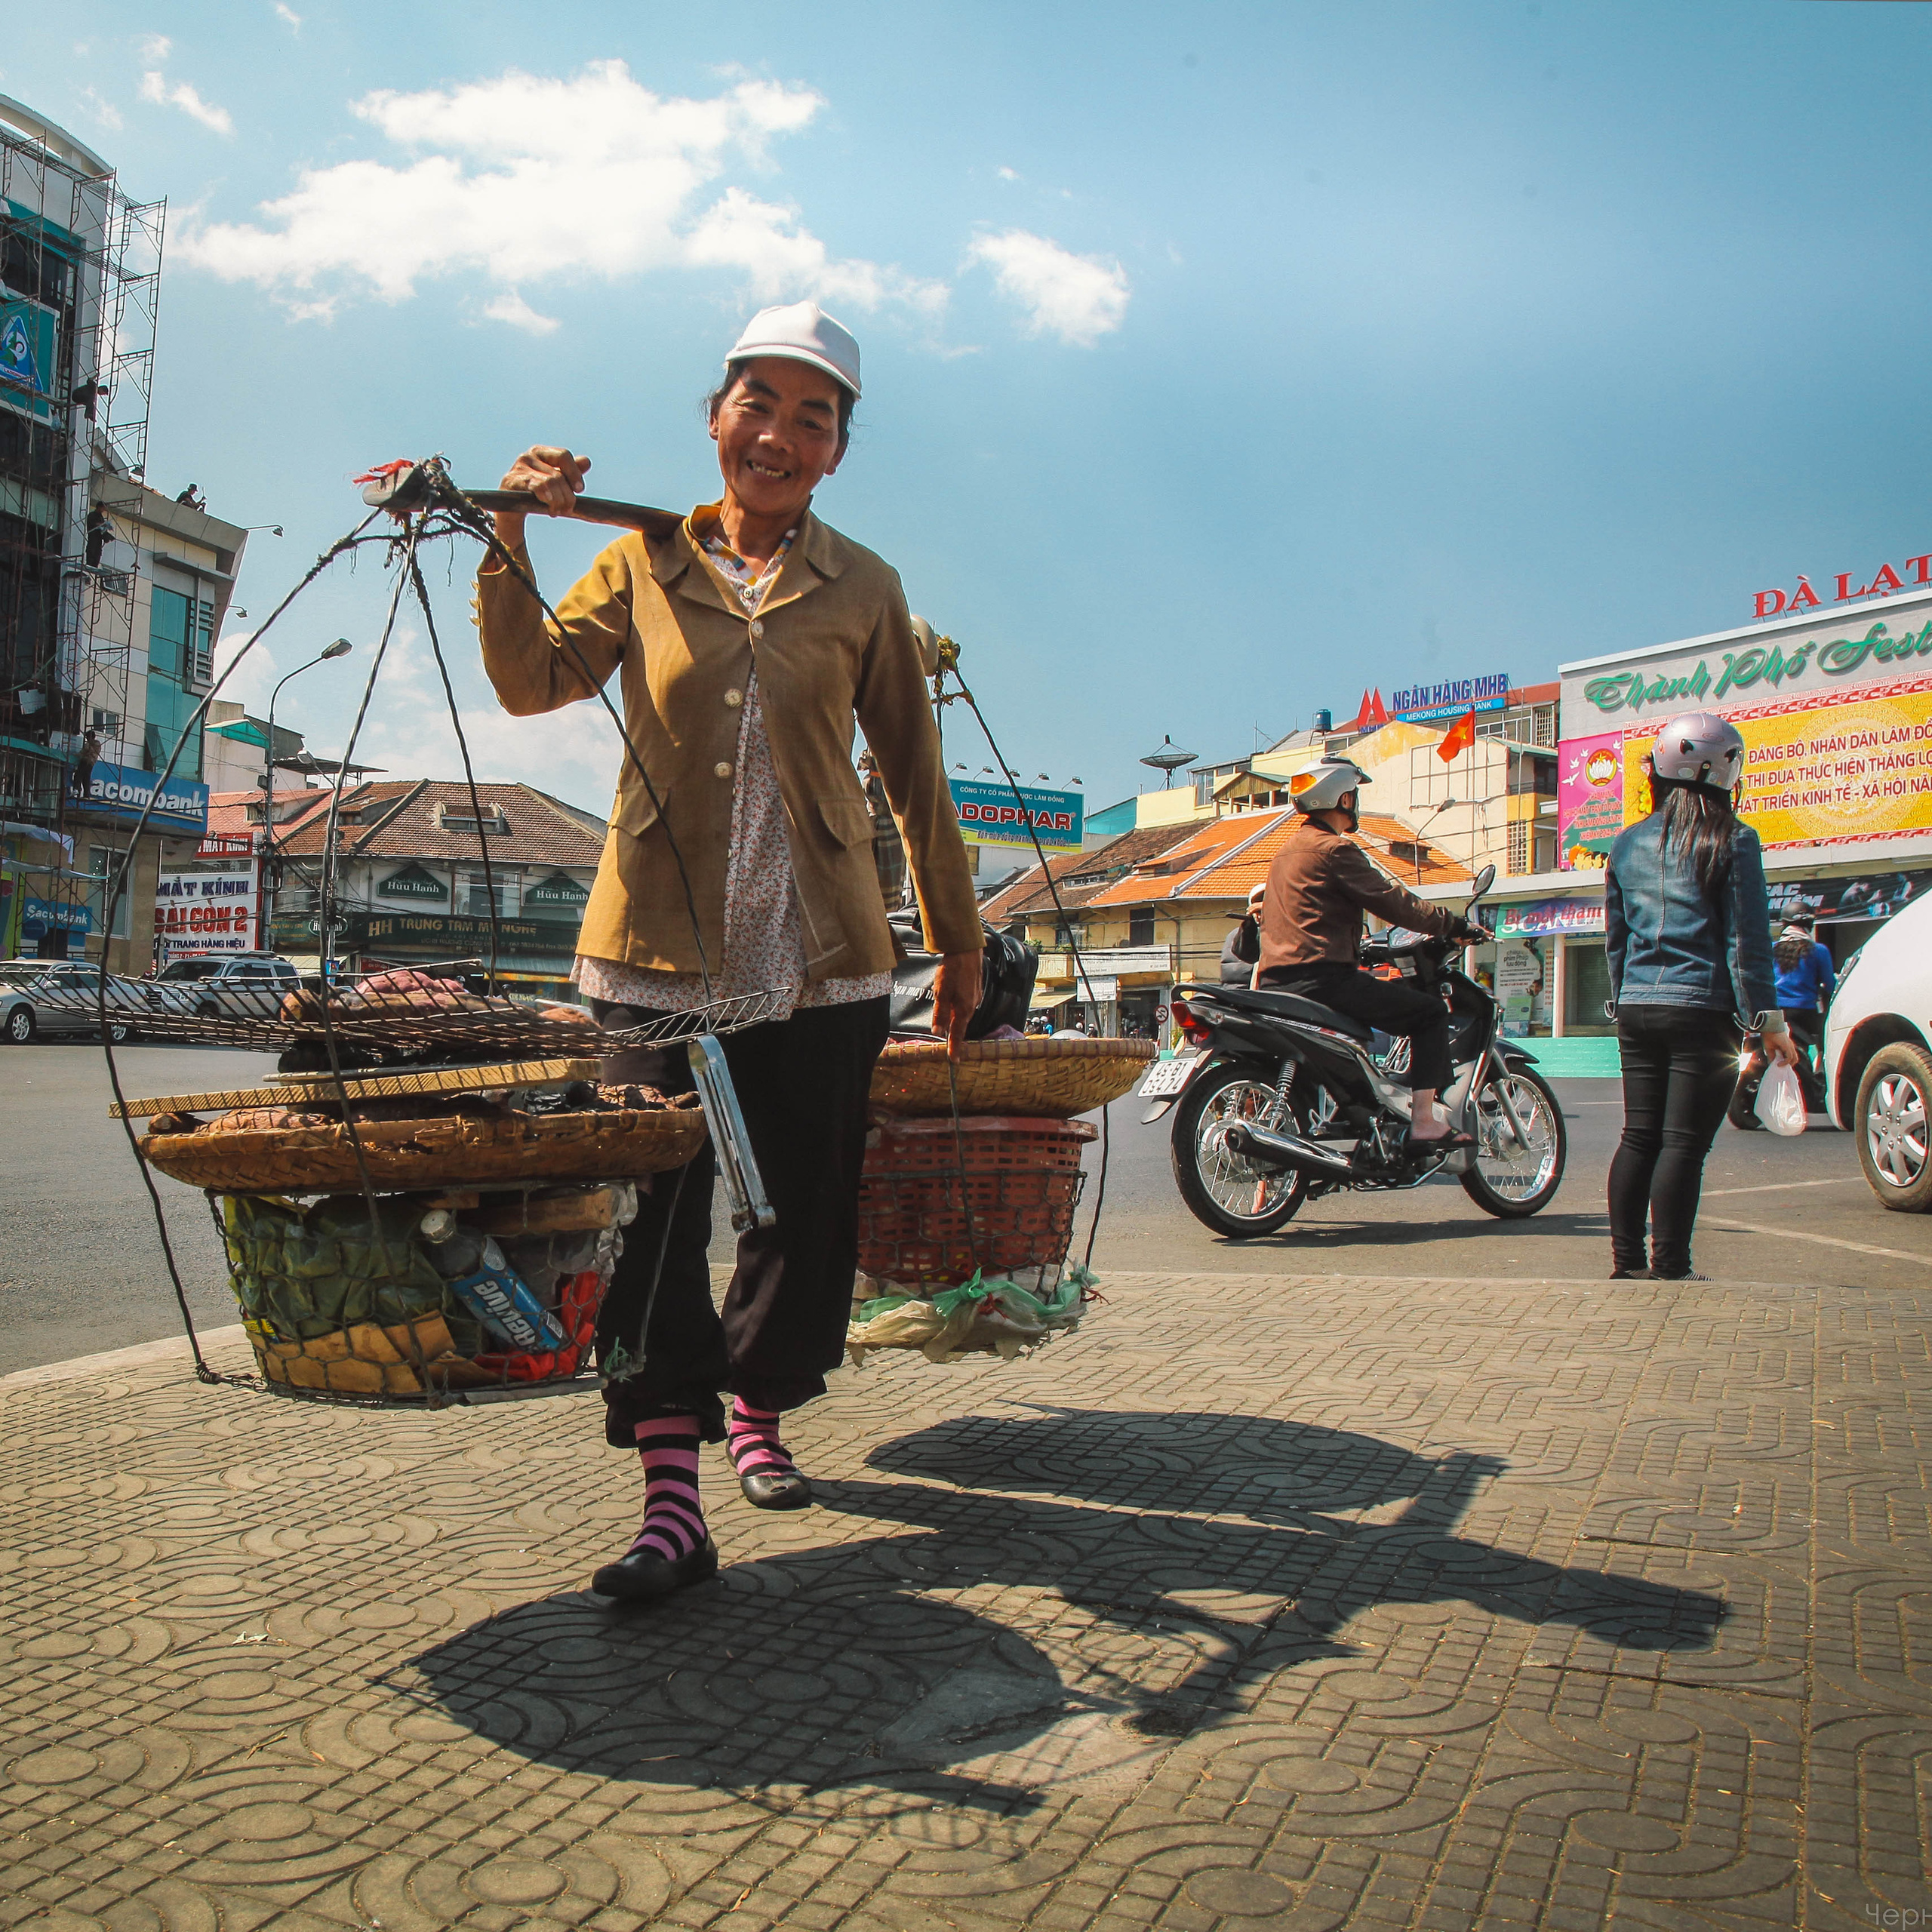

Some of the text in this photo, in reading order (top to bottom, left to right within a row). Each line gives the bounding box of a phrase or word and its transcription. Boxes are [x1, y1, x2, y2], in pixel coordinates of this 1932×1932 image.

[1752, 553, 1932, 618] ĐÀ LẠT
[1392, 673, 1508, 712] NGÂN HÀNG MHB
[1584, 659, 1711, 710] Thành
[1713, 639, 1817, 696] Phố
[1406, 709, 1437, 721] MEKONG
[1438, 704, 1470, 716] HOUSING
[1749, 744, 1783, 764] ĐẢNG
[1810, 734, 1847, 755] NHÂN
[1850, 729, 1878, 749] DÂN
[1881, 724, 1911, 744] LÂM
[1746, 772, 1765, 789] THI
[1768, 770, 1795, 786] ĐUA
[1798, 763, 1832, 783] THỰC
[1835, 757, 1865, 777] HIỆN
[1869, 748, 1915, 772] THẮNG
[72, 771, 205, 817] acombank
[1761, 788, 1798, 810] TRIỂN
[1801, 792, 1832, 807] KINH
[1835, 782, 1852, 801] TẾ
[1863, 780, 1880, 798] XÃ
[1883, 776, 1906, 798] HỘI
[202, 877, 249, 896] KÍNH
[189, 898, 232, 934] GÒN
[234, 906, 248, 934] 2
[368, 918, 393, 937] HH
[399, 918, 443, 931] TRUNG
[173, 940, 199, 948] TRANG
[201, 938, 225, 948] HÀNG
[226, 937, 245, 950] HIỆU
[906, 986, 925, 1001] may
[473, 1280, 536, 1346] Revive
